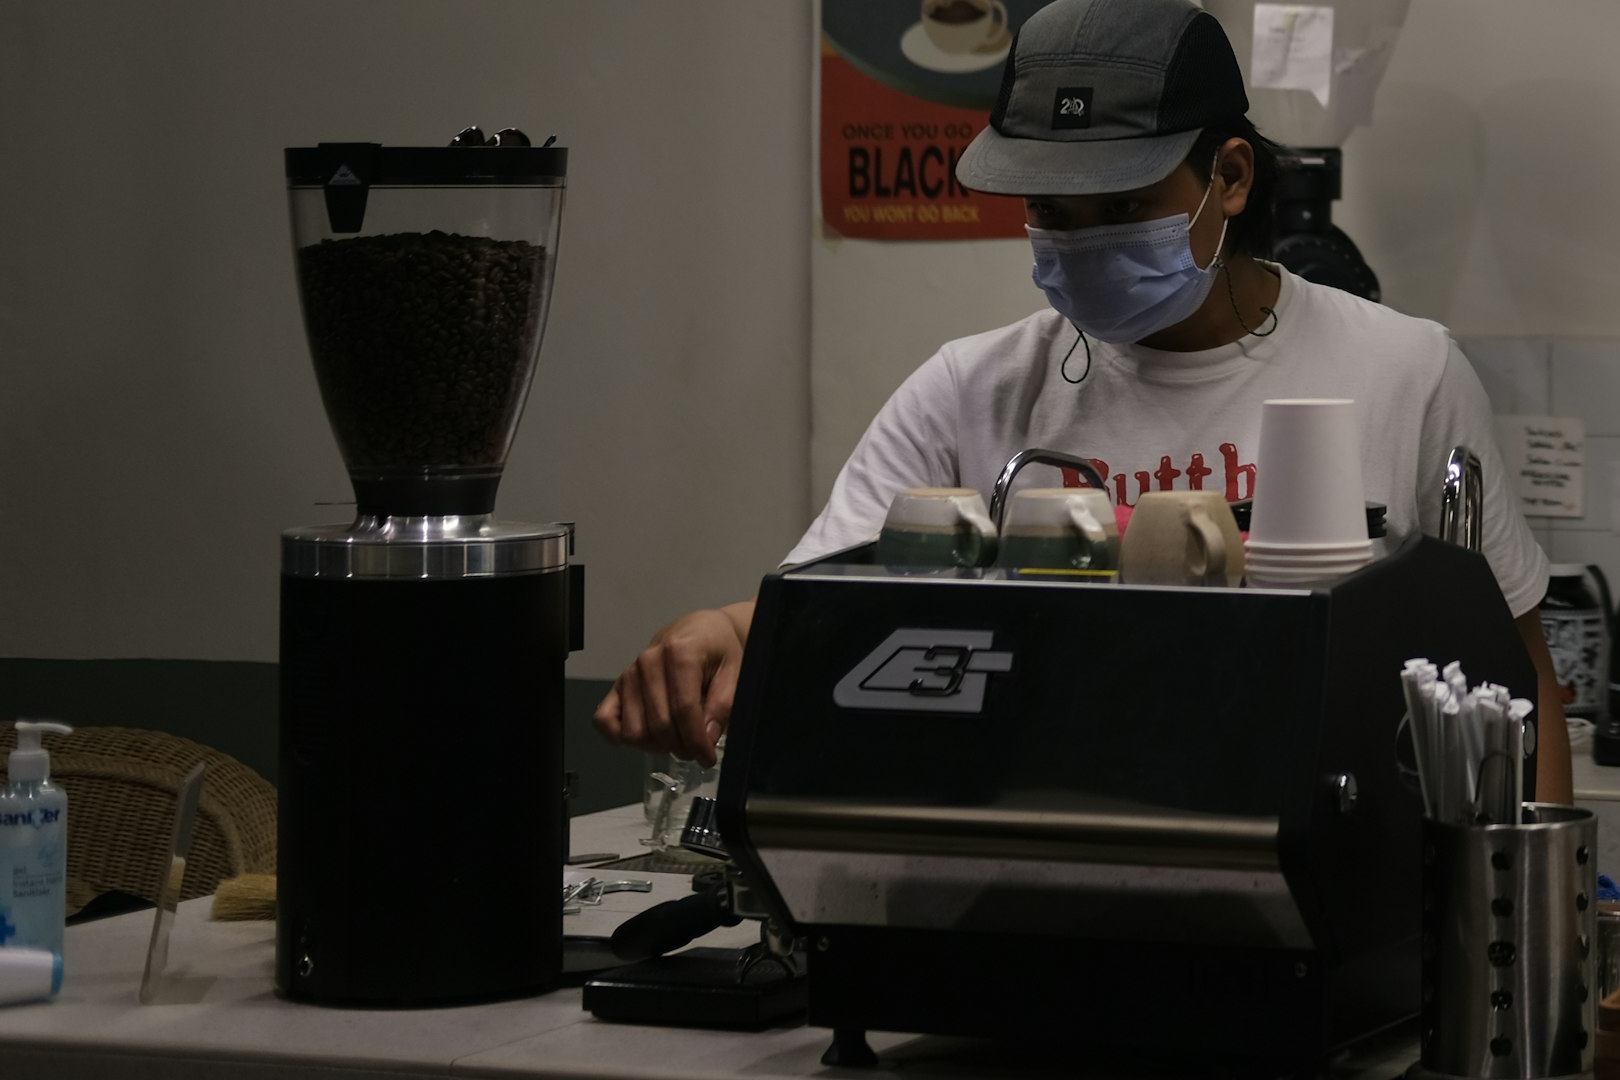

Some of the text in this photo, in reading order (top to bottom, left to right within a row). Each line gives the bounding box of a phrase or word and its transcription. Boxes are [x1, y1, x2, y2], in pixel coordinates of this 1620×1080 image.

[842, 123, 973, 139] ONCE YOU GO
[843, 205, 869, 223] YOU
[917, 205, 940, 222] GO
[942, 205, 980, 223] BACK
